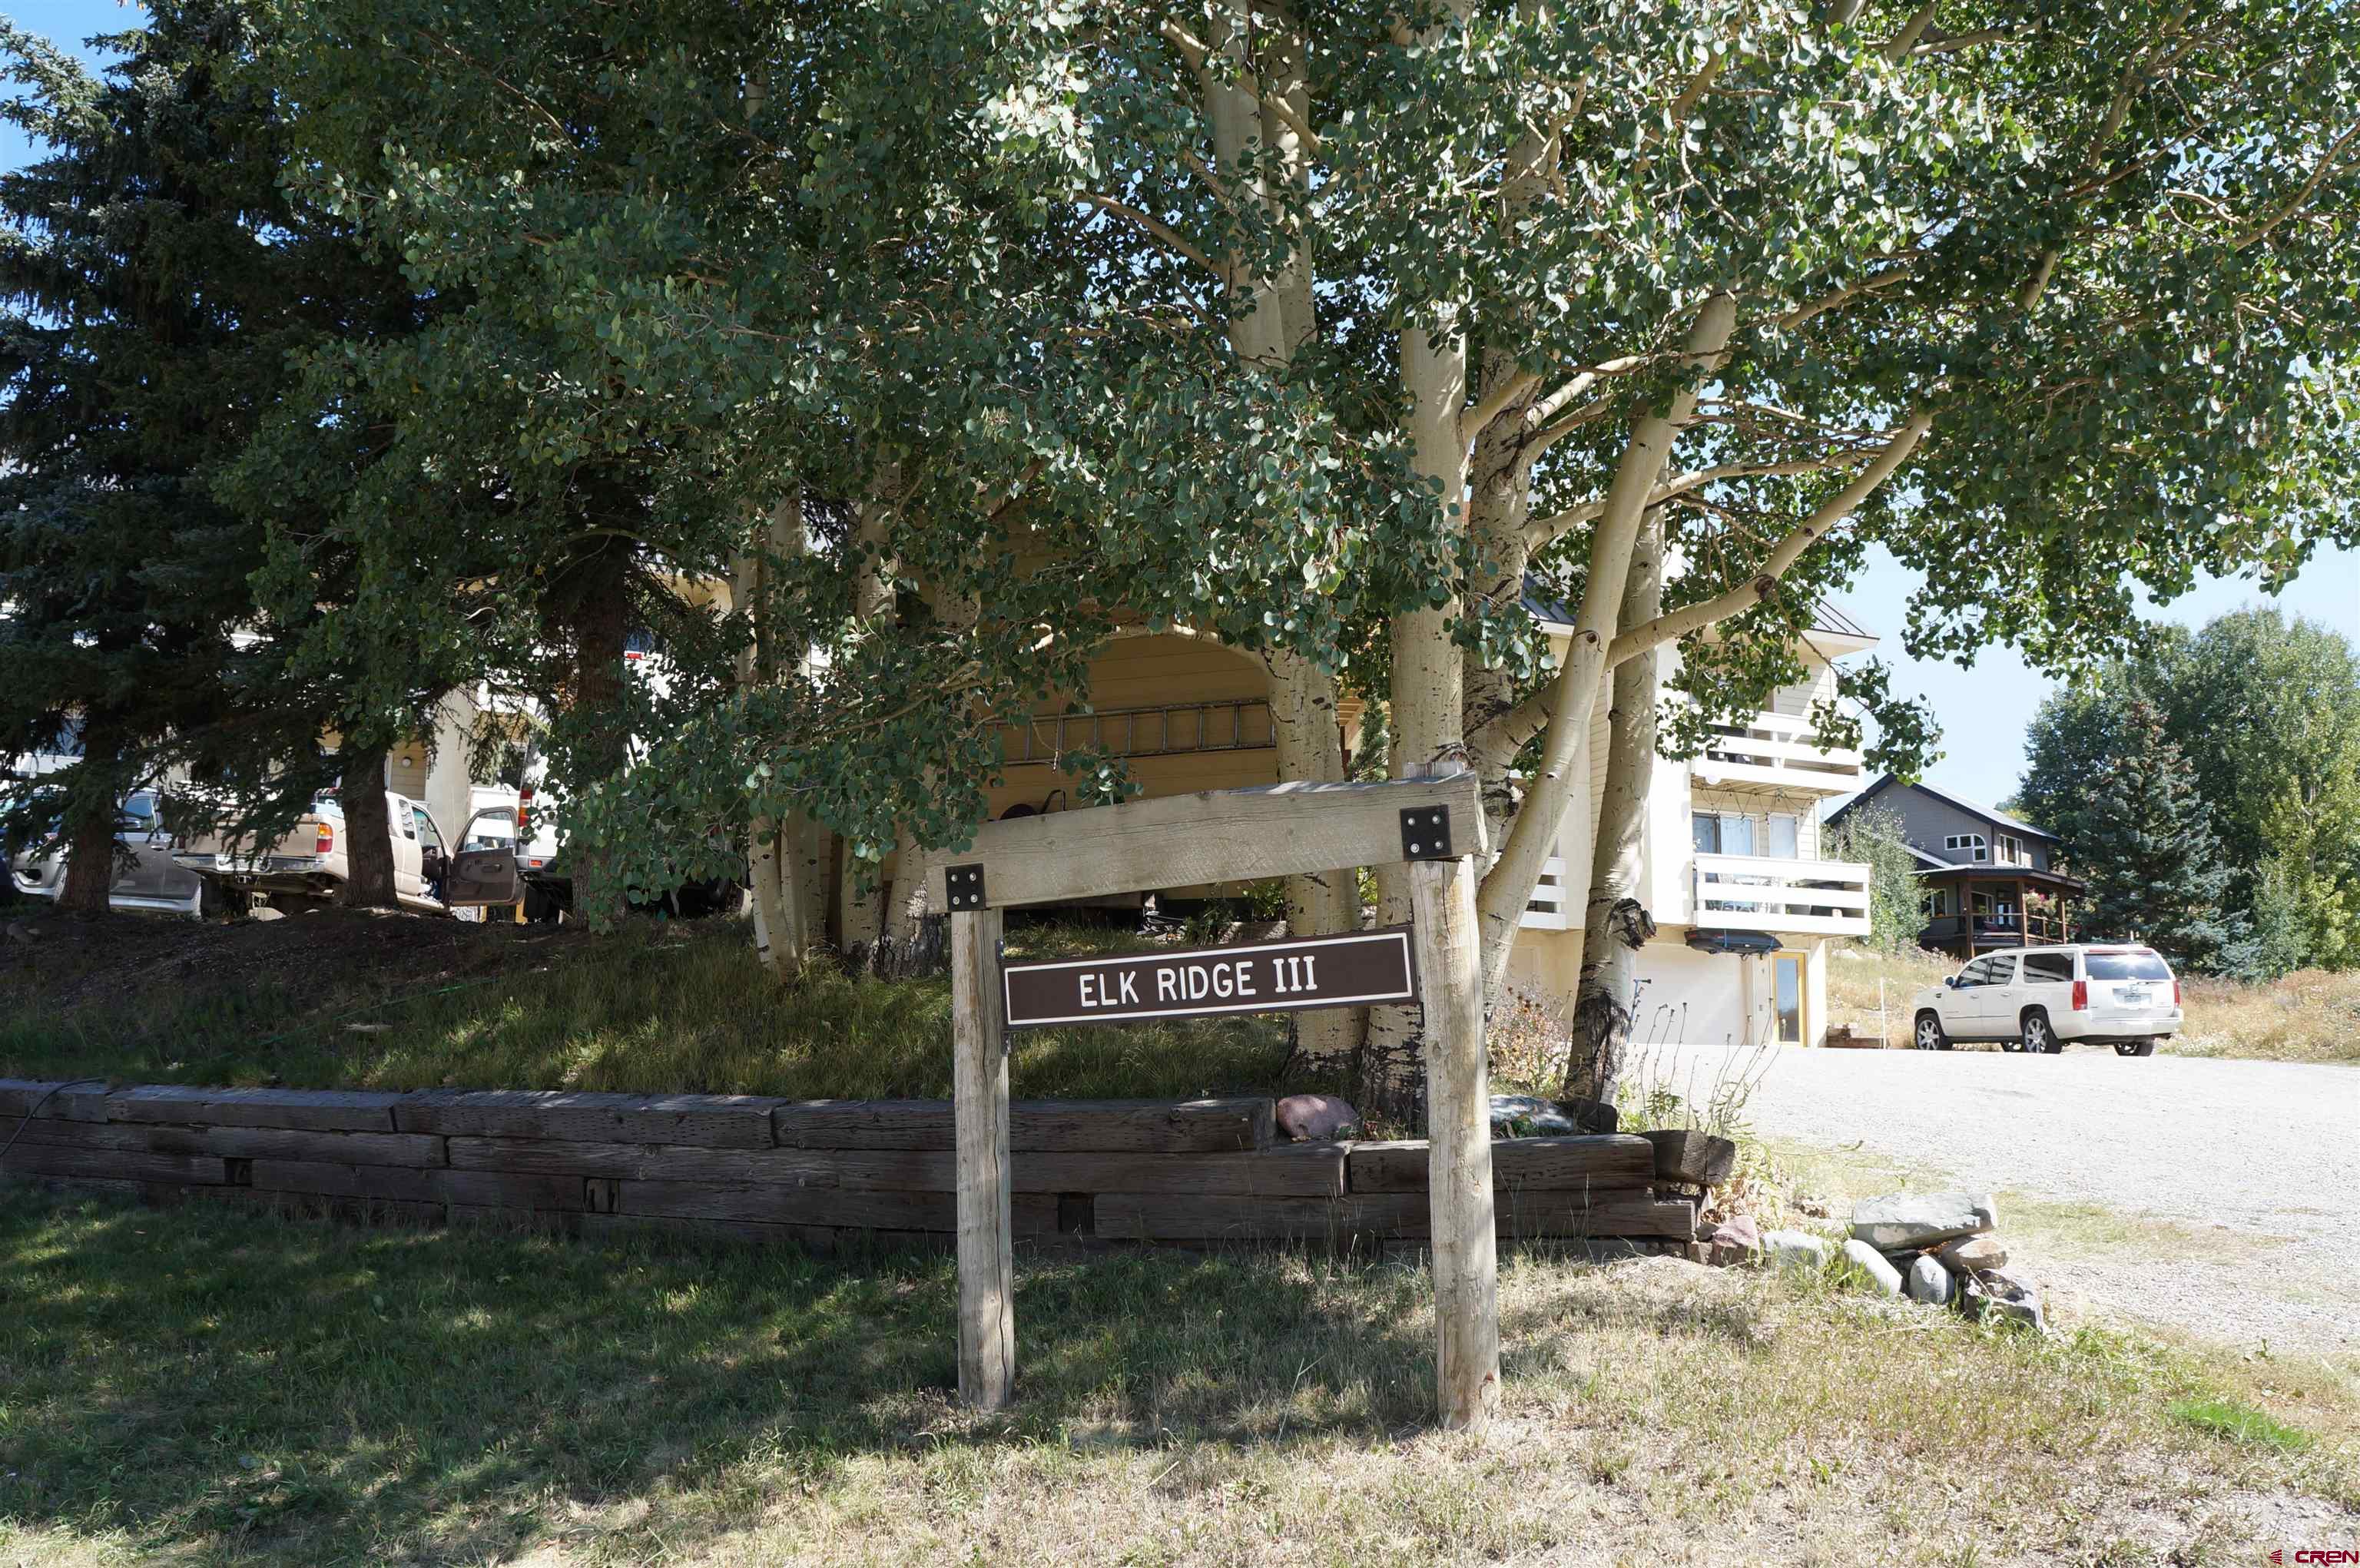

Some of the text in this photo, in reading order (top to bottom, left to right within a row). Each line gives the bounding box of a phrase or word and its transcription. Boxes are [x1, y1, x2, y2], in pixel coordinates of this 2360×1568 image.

[1079, 955, 1318, 1007] ELK RIDGE III
